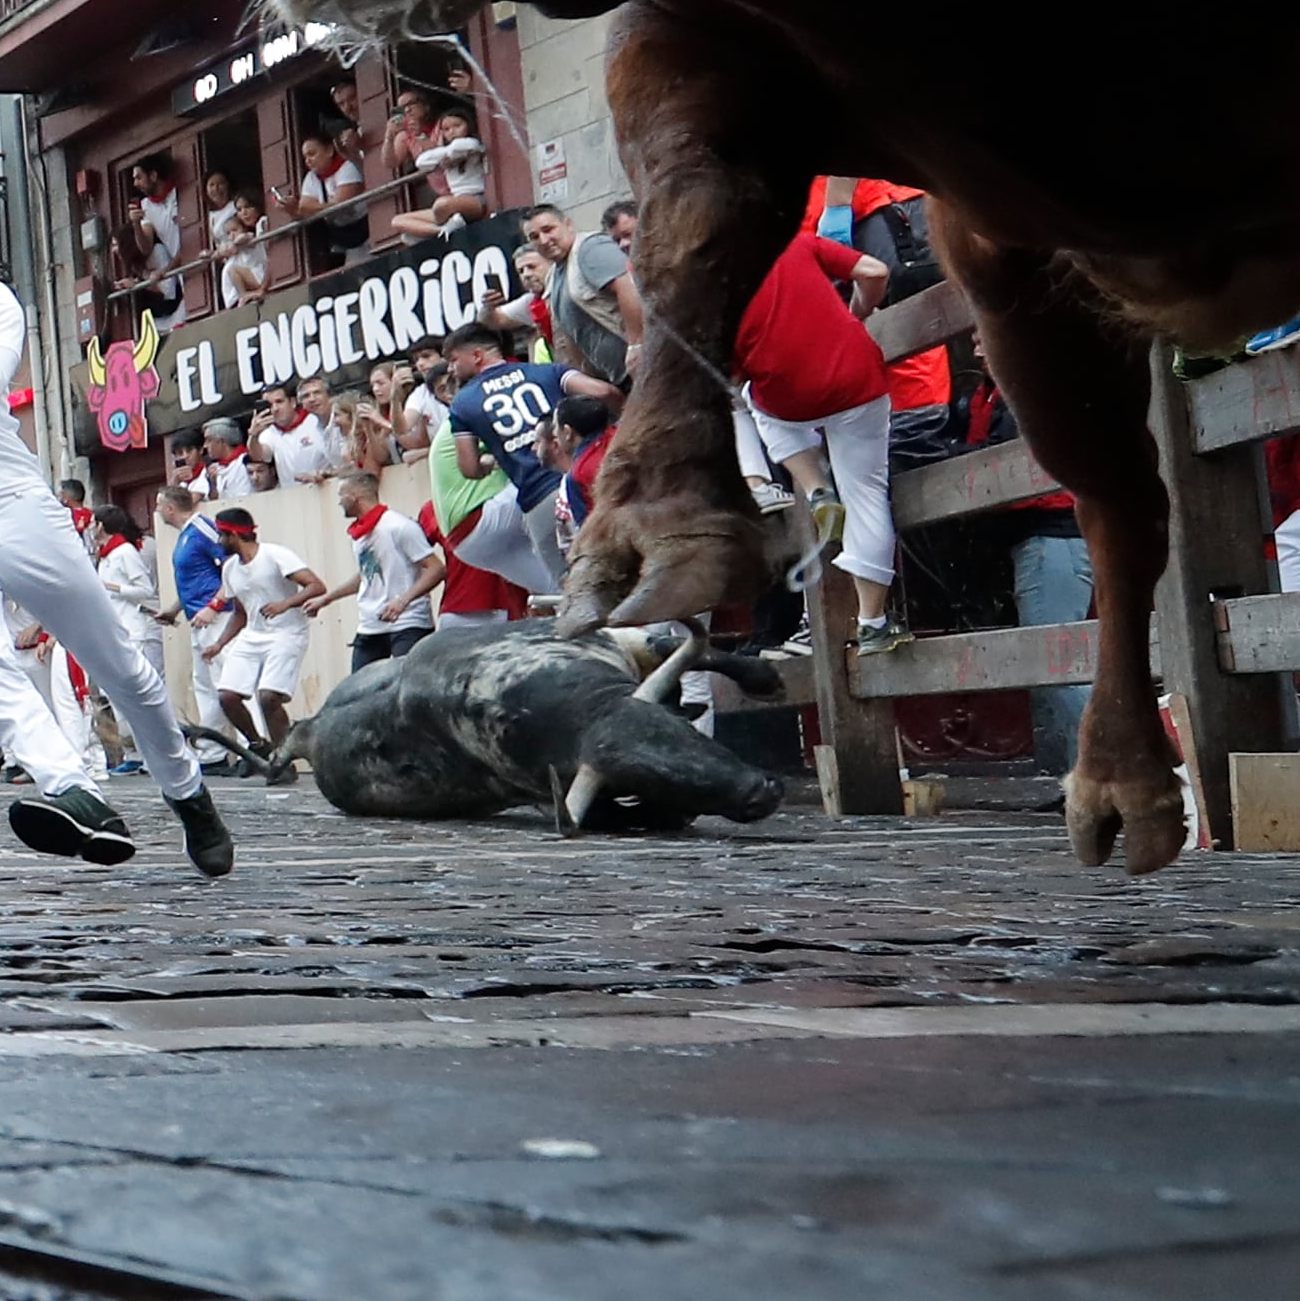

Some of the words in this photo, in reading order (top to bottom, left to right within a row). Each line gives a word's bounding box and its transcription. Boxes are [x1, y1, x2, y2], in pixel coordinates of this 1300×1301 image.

[176, 340, 223, 412] EL
[482, 368, 525, 395] MESSI
[483, 382, 552, 436] 30
